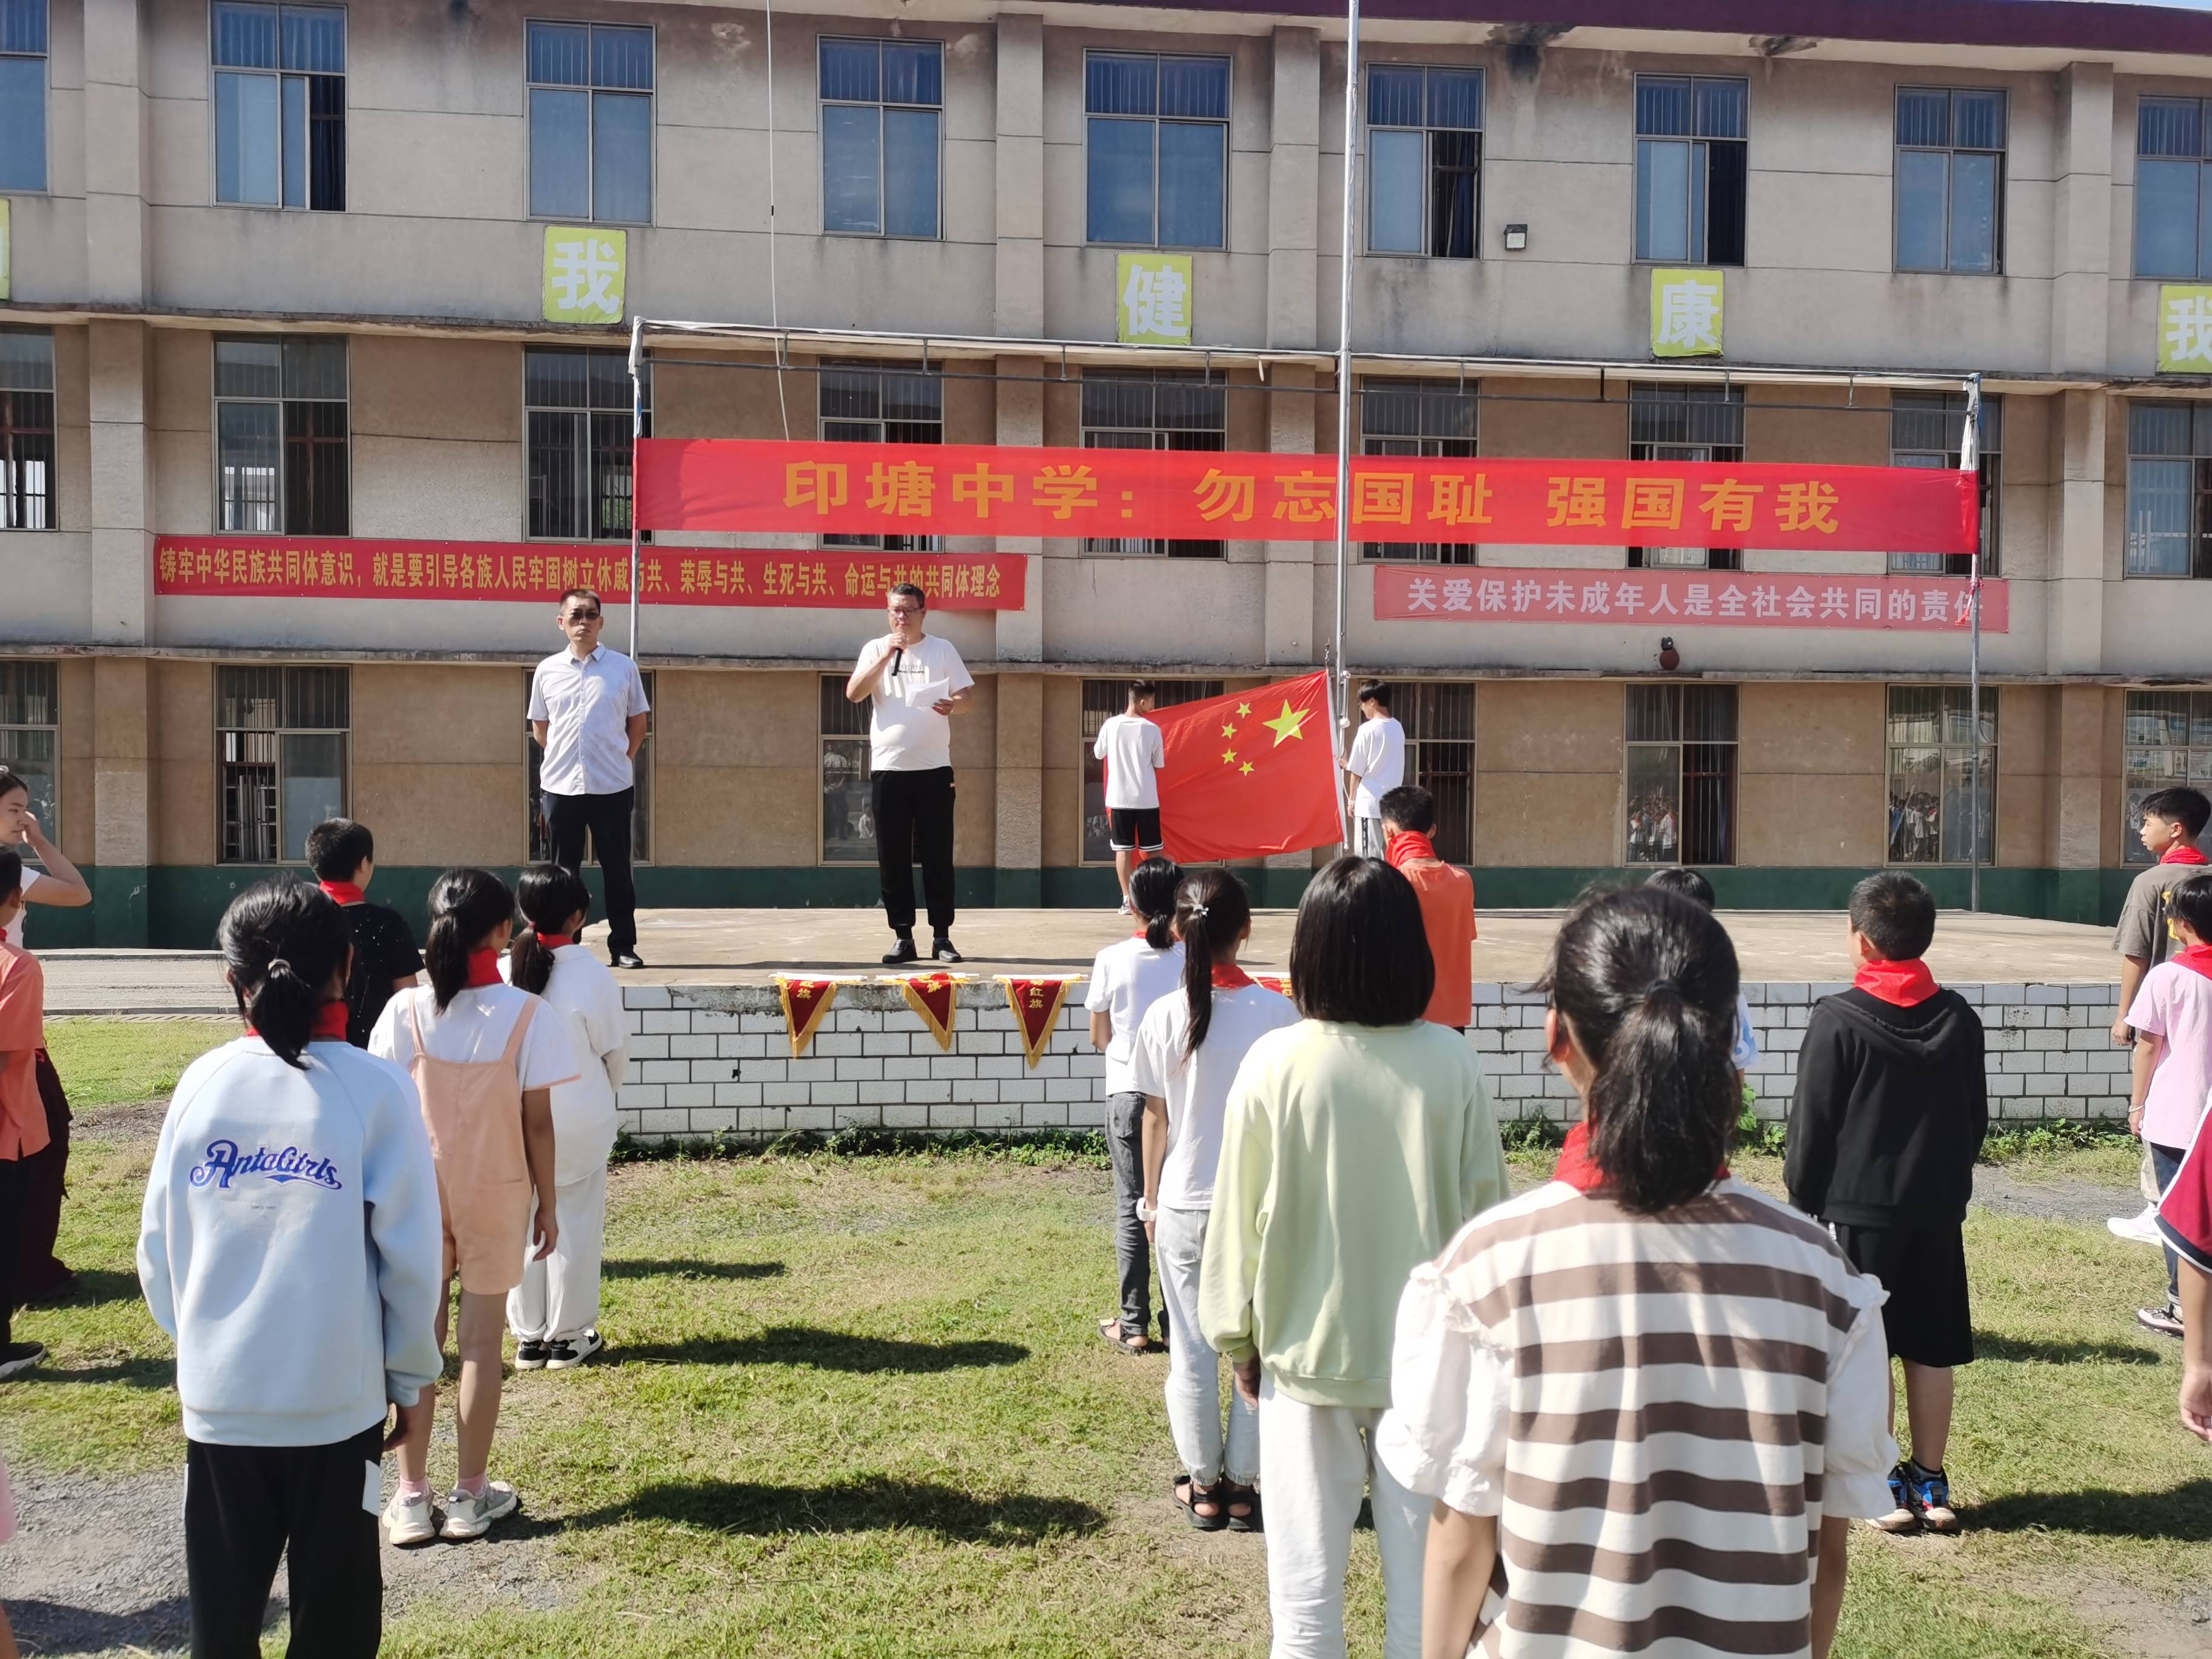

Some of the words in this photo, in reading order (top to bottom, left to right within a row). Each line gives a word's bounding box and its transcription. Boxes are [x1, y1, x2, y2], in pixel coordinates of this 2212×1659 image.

[552, 238, 620, 314] 我
[1123, 264, 1187, 337] 健
[1658, 279, 1719, 348] 康
[2166, 295, 2212, 364] 我
[1547, 477, 1840, 534] 强国有我
